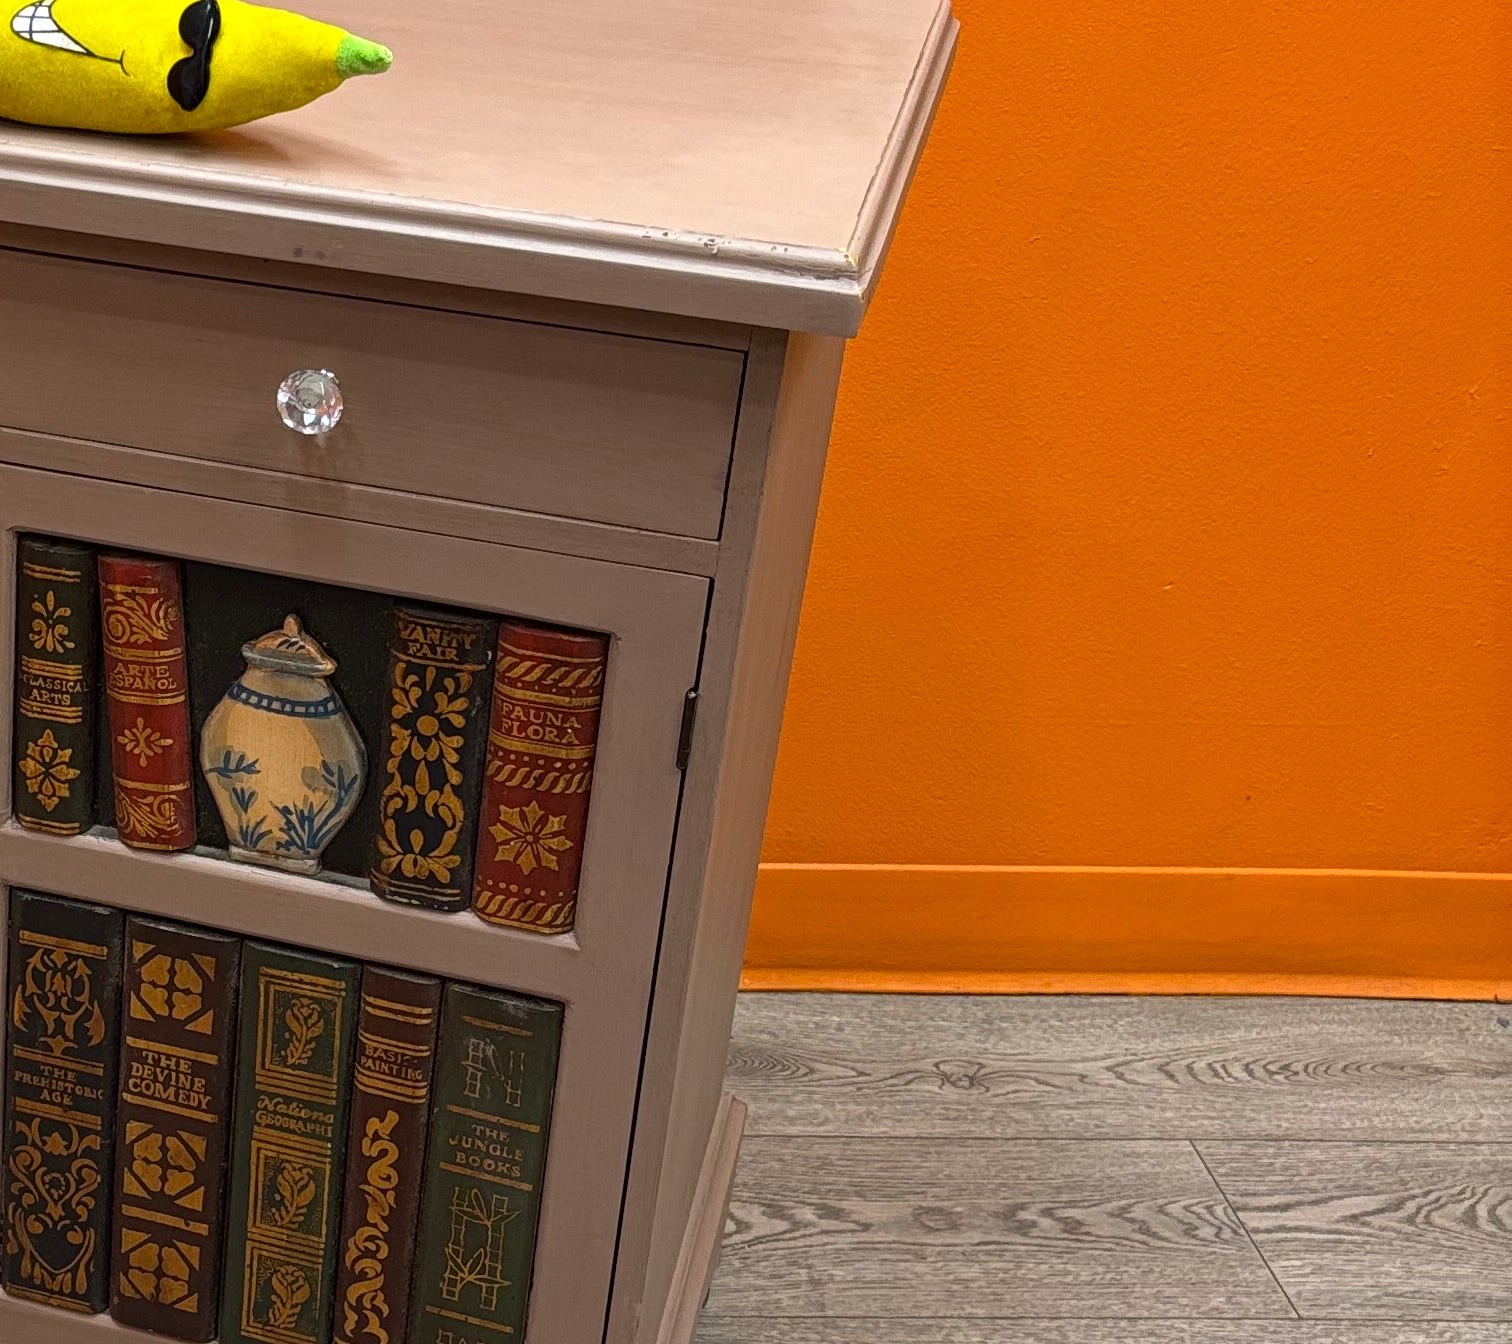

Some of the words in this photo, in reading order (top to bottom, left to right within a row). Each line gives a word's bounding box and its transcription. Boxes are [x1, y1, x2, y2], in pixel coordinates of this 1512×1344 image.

[399, 620, 476, 650] VANITY
[407, 642, 459, 661] FAIR
[113, 663, 170, 678] ARTE
[22, 674, 88, 693] CLASSICAL
[29, 688, 71, 705] ARTS
[502, 702, 582, 729] FAUNA
[501, 717, 581, 745] FLORA
[39, 1065, 78, 1082] THE
[142, 1050, 192, 1073] THE
[360, 1056, 423, 1080] PAINTING
[13, 1070, 104, 1100] PREHISTORIC
[130, 1061, 206, 1093] DEVINE
[39, 1088, 73, 1106] AGE
[128, 1077, 213, 1110] COMEDY
[471, 1124, 510, 1143] THE
[449, 1135, 524, 1162] JUNGLE
[455, 1151, 521, 1177] BOOKS
